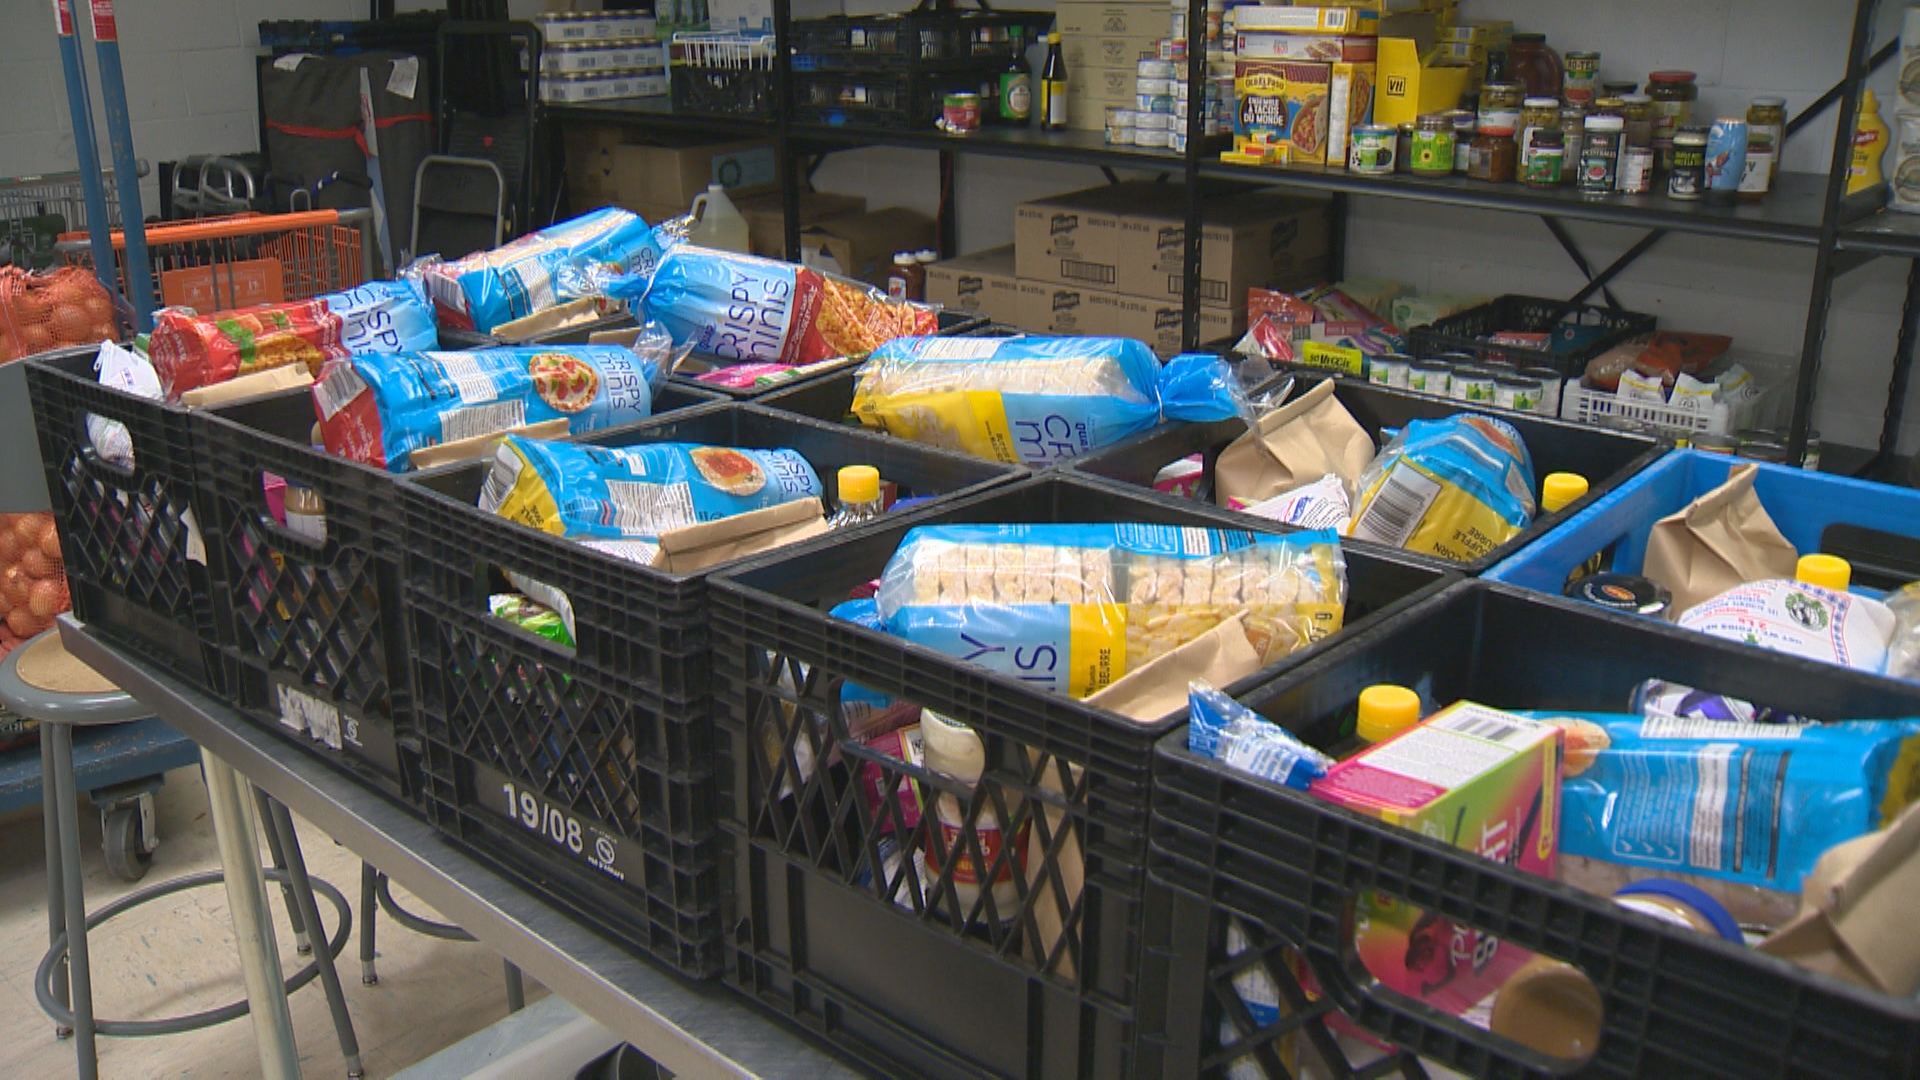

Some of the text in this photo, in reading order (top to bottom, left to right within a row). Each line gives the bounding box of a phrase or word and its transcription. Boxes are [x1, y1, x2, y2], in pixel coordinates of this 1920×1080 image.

[1243, 113, 1284, 126] DU MONDE
[1254, 104, 1279, 114] TACOS
[714, 274, 760, 360] CRISPY
[615, 350, 641, 413] CRISPY
[503, 782, 585, 855] 19/08
